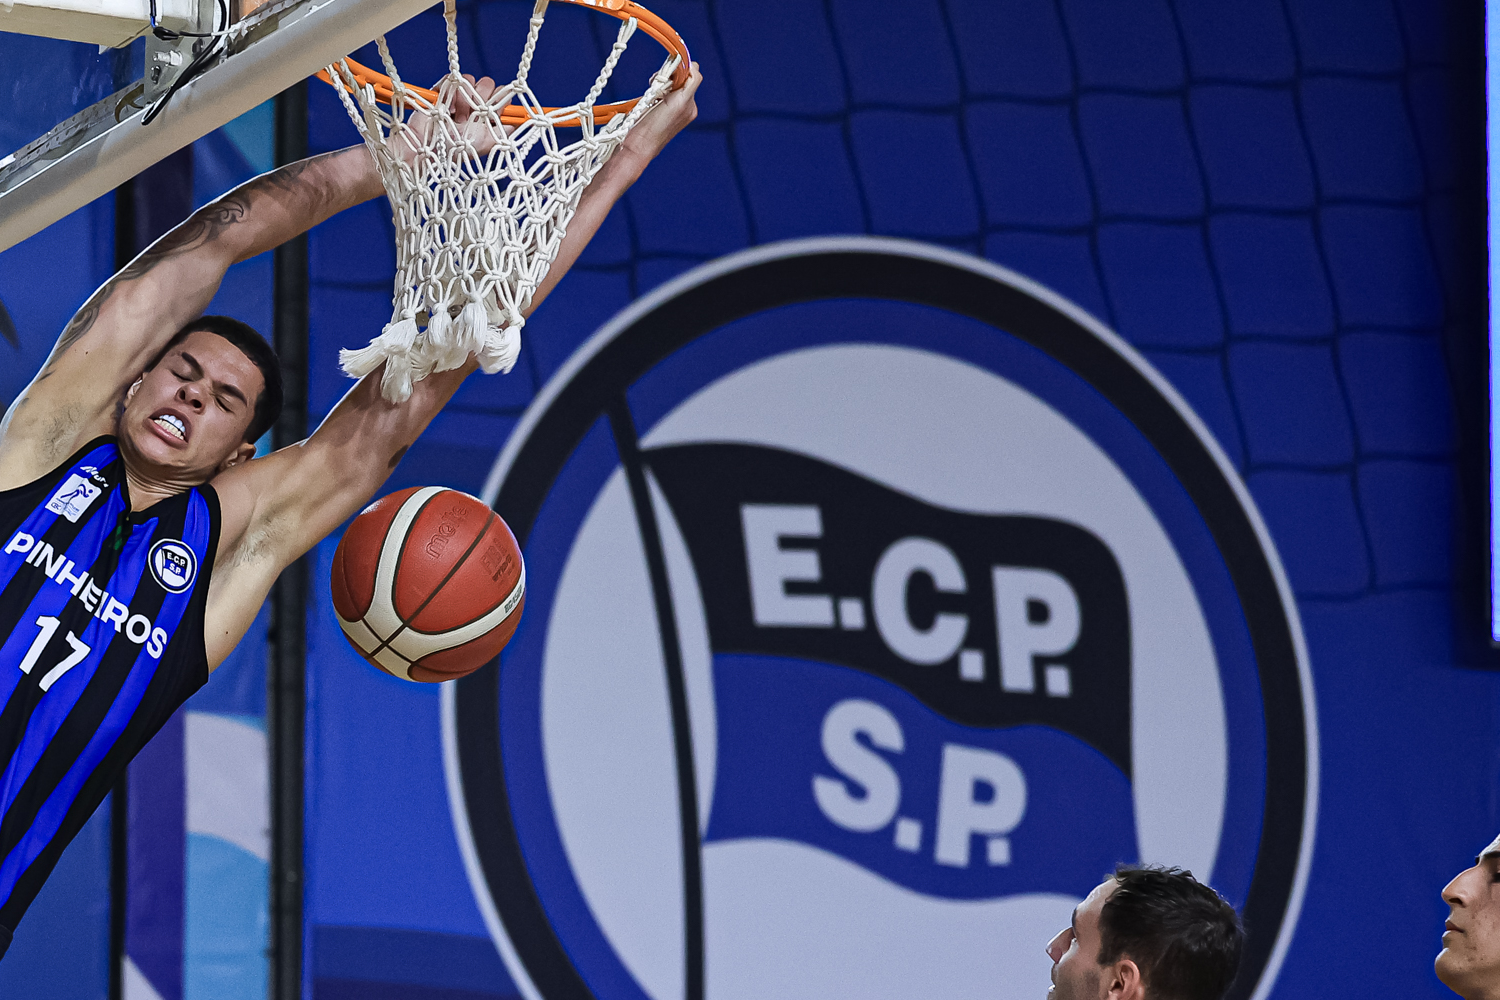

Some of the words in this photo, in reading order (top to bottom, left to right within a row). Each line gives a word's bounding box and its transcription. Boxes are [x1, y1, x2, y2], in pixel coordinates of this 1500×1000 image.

[4, 530, 168, 659] PINHEIROS
[19, 614, 91, 692] 17
[739, 502, 1082, 697] E.C.P.
[812, 698, 1027, 869] S.P.
